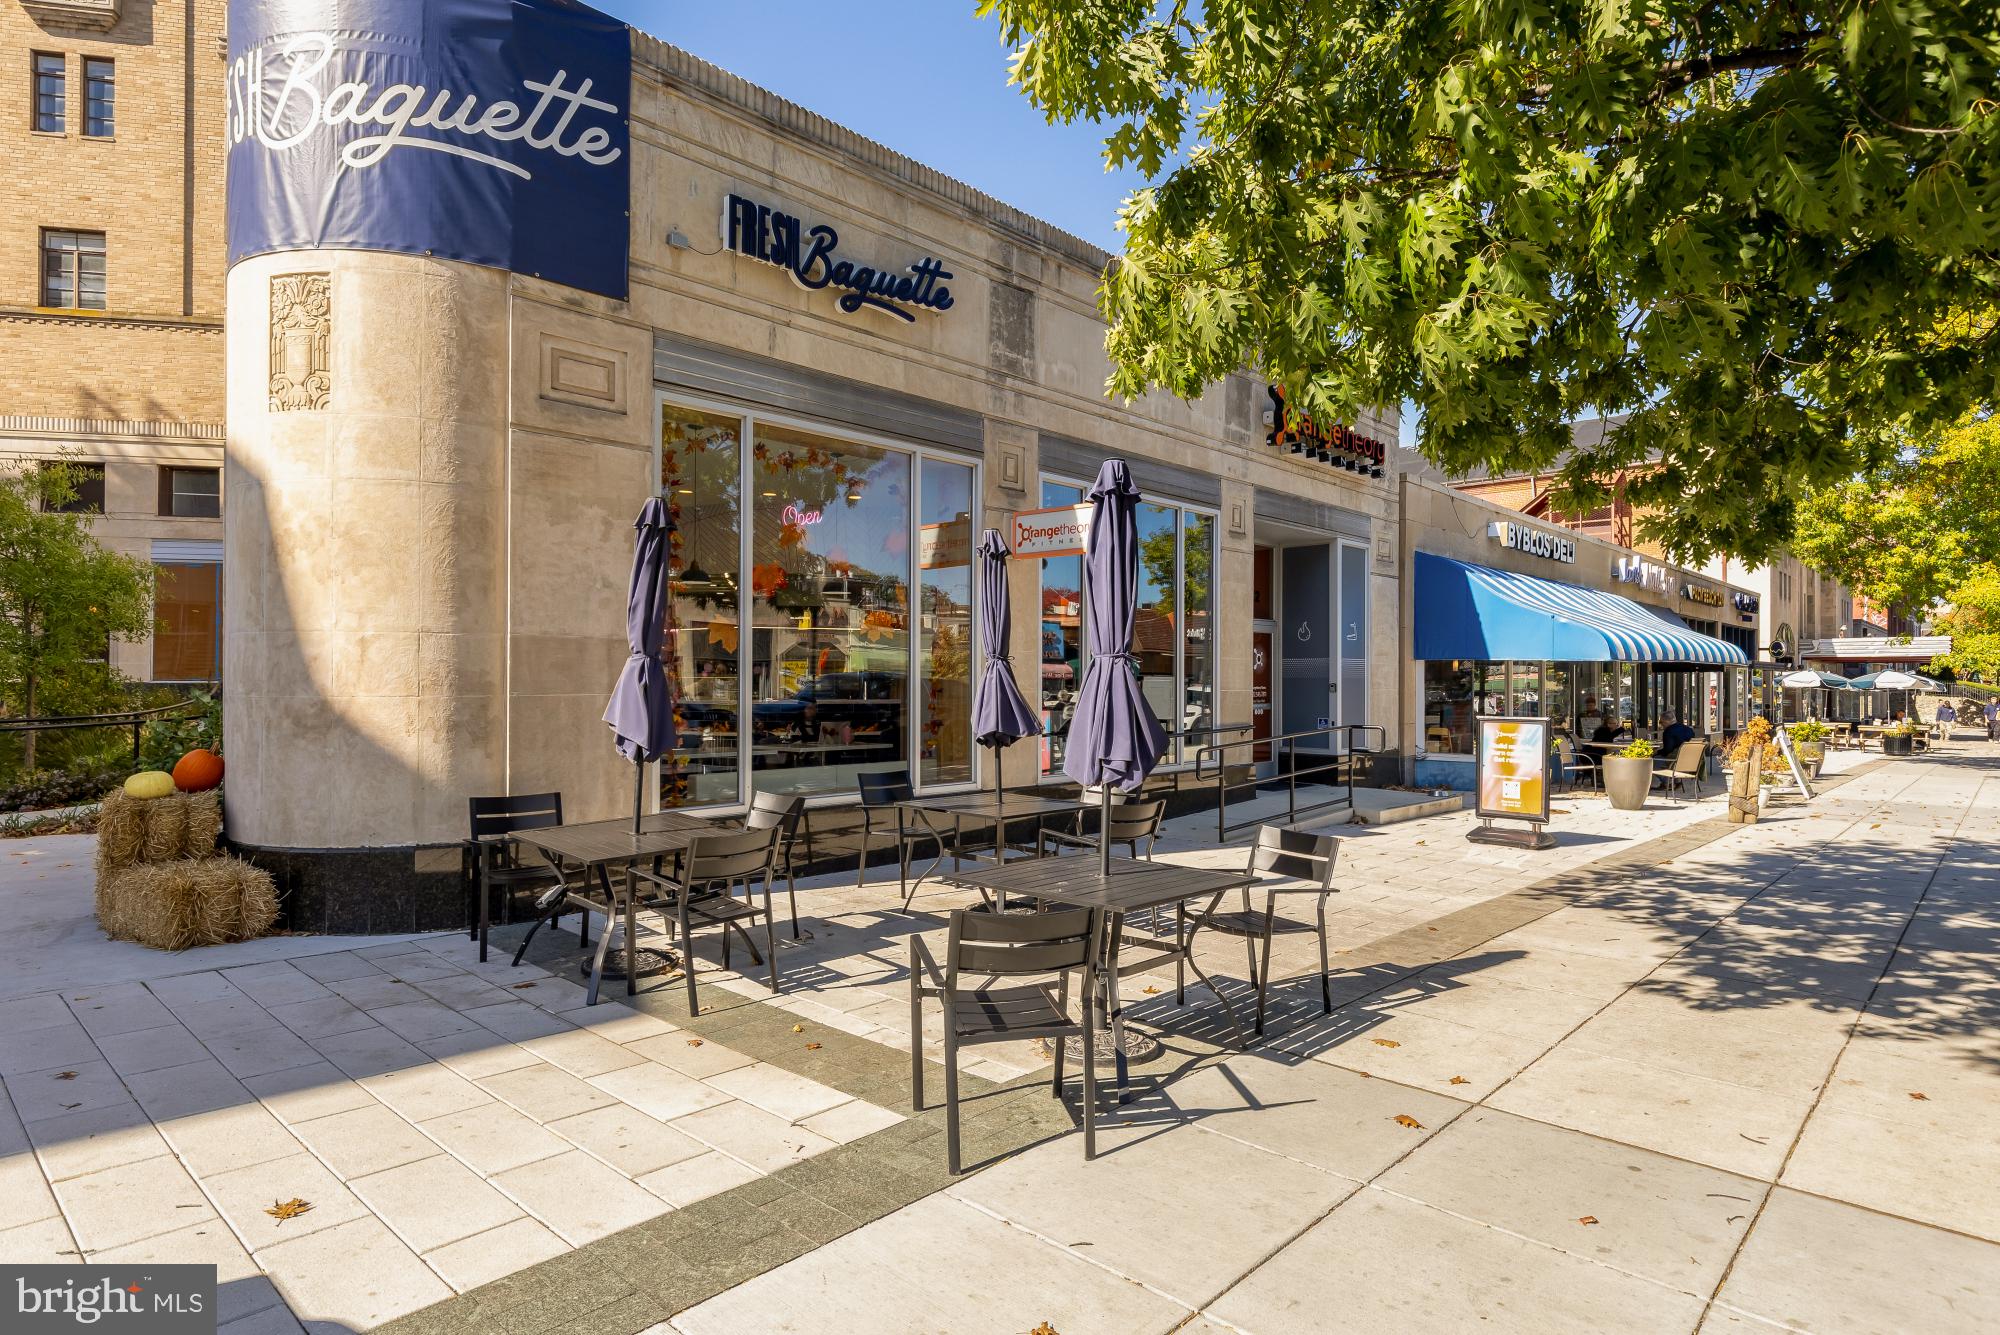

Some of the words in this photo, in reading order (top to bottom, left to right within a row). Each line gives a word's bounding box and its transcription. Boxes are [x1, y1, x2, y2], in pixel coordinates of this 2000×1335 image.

[262, 32, 621, 180] Baguette
[723, 194, 800, 270] FRESH
[796, 225, 954, 323] Baguette
[783, 505, 823, 526] Open
[1018, 522, 1090, 547] Orangetheor
[1032, 537, 1082, 547] FITNE
[1508, 522, 1551, 558] BYBLOS
[1553, 536, 1576, 564] DELI
